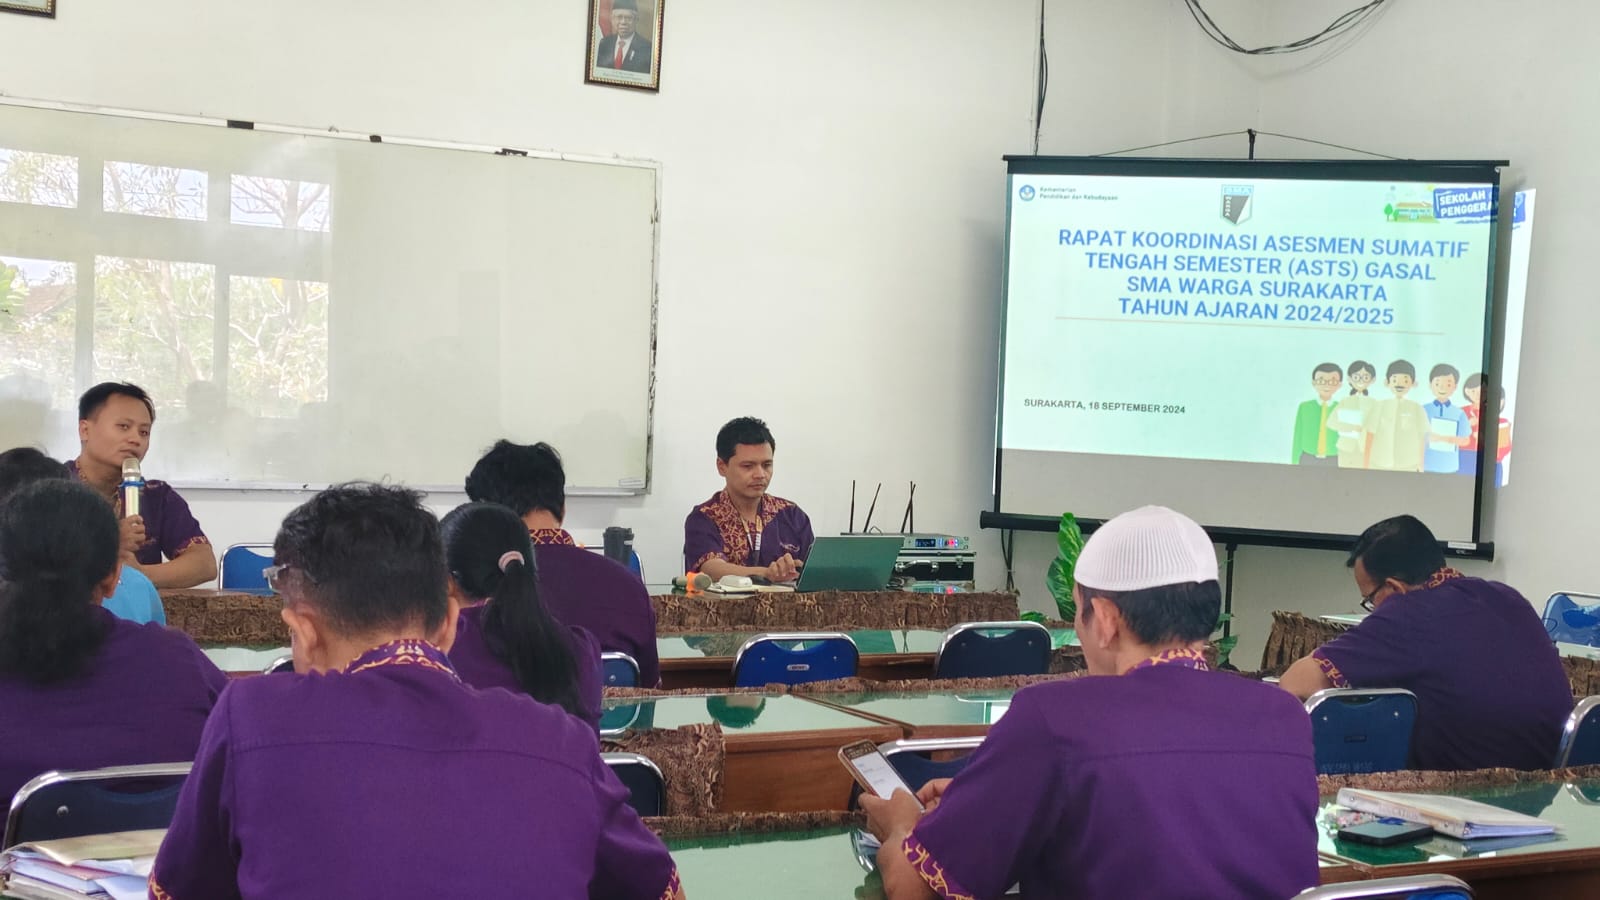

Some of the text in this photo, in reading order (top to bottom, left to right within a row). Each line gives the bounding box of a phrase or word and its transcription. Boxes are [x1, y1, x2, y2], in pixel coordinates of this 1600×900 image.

[1439, 190, 1486, 206] SEKOLAH
[1058, 229, 1470, 258] RAPAT KOORDINASI ASESMEN SUMATIF
[1085, 252, 1436, 282] TENGAH SEMESTER (ASTS) GASAL
[1127, 275, 1387, 302] SMA WARGA SURAKARTA
[1118, 297, 1394, 325] TAHUN AJARAN 2024/2025
[1024, 398, 1186, 414] SURAKARTA, 18 SEPTEMBER 2024
